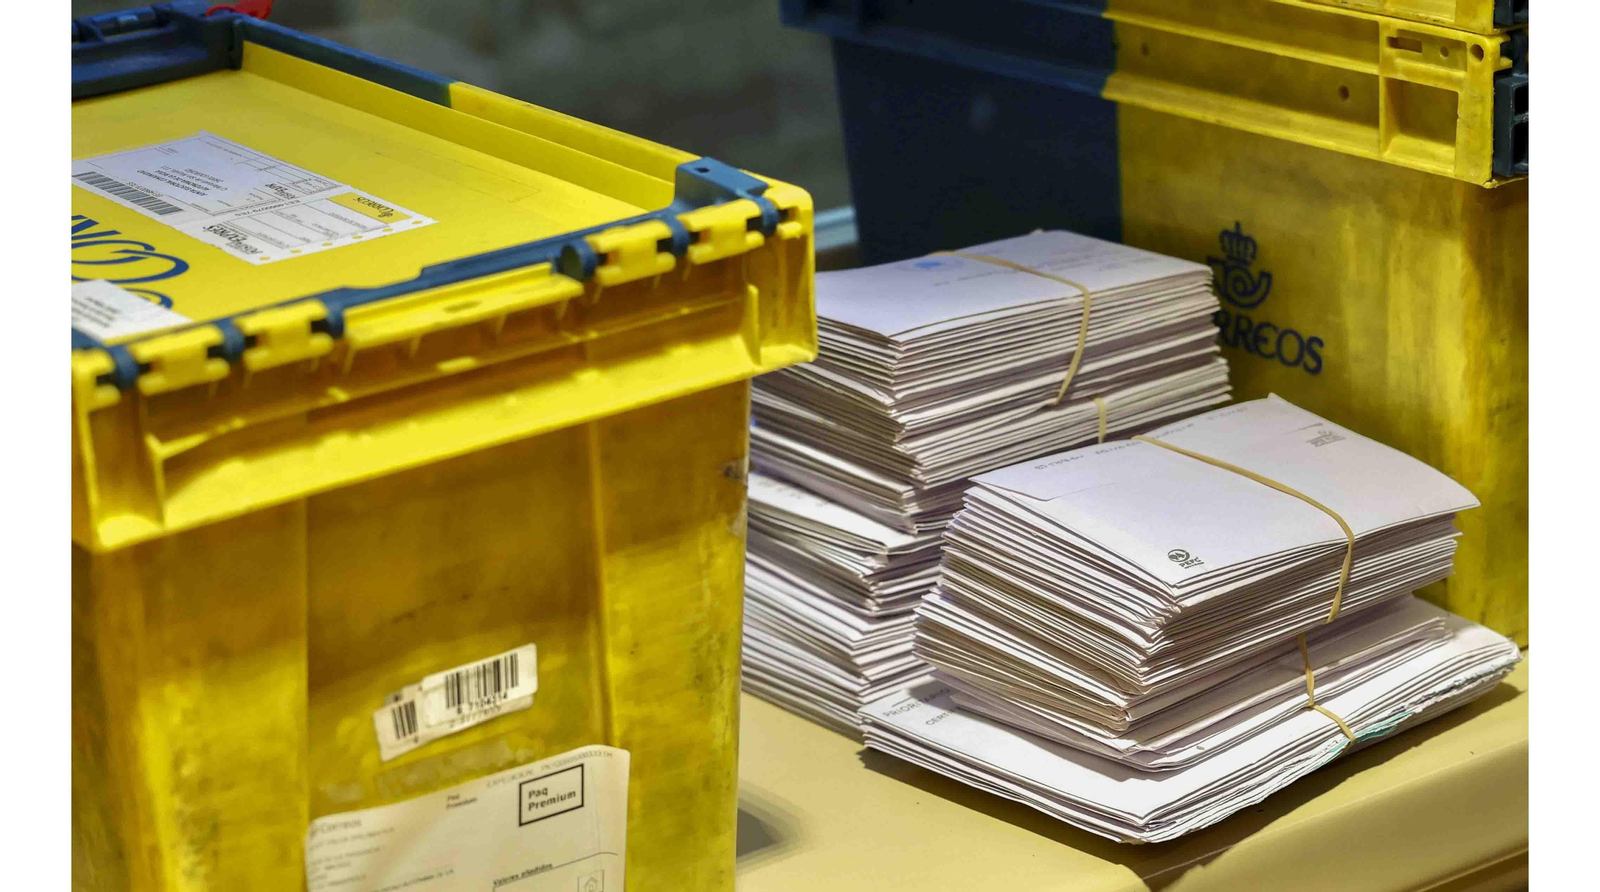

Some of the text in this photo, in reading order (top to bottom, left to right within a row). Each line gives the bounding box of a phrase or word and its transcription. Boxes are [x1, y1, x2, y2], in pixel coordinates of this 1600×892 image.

[1213, 309, 1324, 375] RREOS
[1179, 556, 1201, 568] PEFC
[527, 786, 549, 800] Paq
[527, 790, 577, 812] Premium
